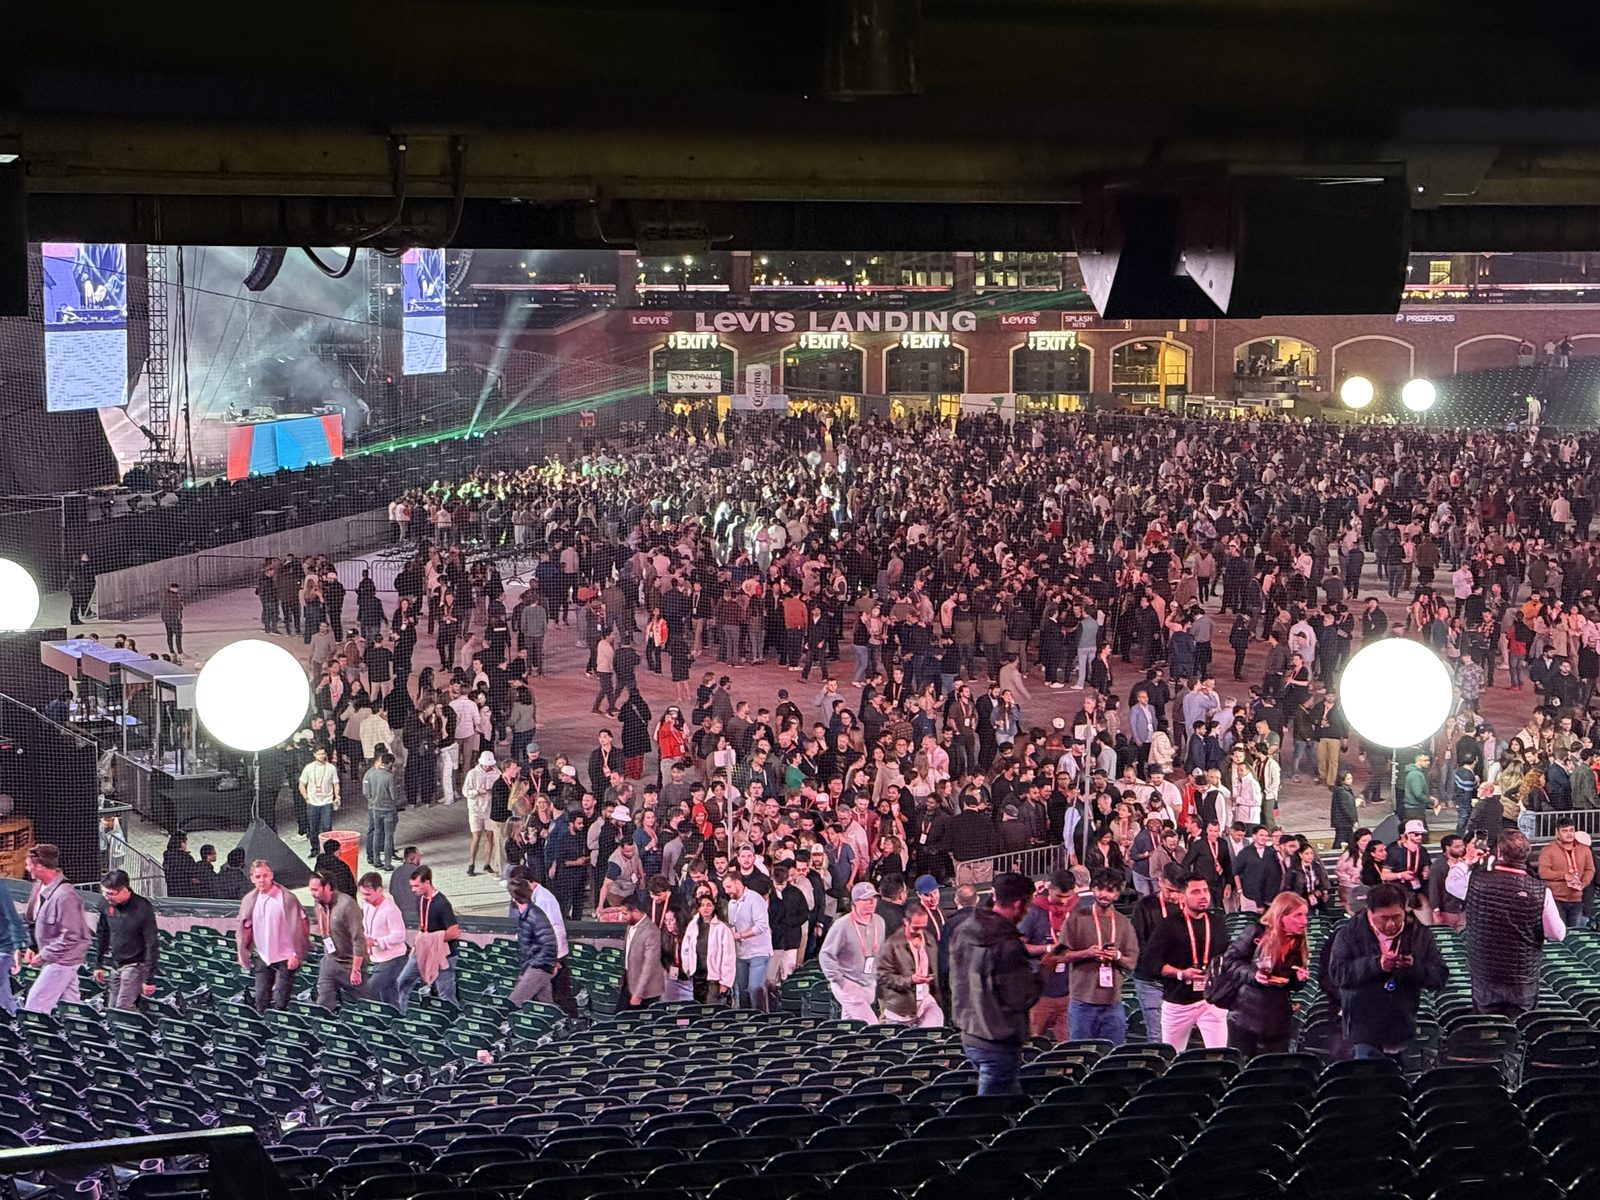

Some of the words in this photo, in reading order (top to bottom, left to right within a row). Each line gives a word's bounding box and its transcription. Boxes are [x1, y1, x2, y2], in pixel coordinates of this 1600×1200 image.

[809, 311, 977, 332] LANDING
[1064, 315, 1093, 323] SPLASH
[1405, 314, 1456, 322] PRIZEPICKS
[676, 334, 710, 349] EXIT
[808, 334, 841, 349] EXIT
[910, 334, 943, 349] EXIT
[1036, 336, 1068, 351] EXIT
[752, 370, 763, 407] Corona
